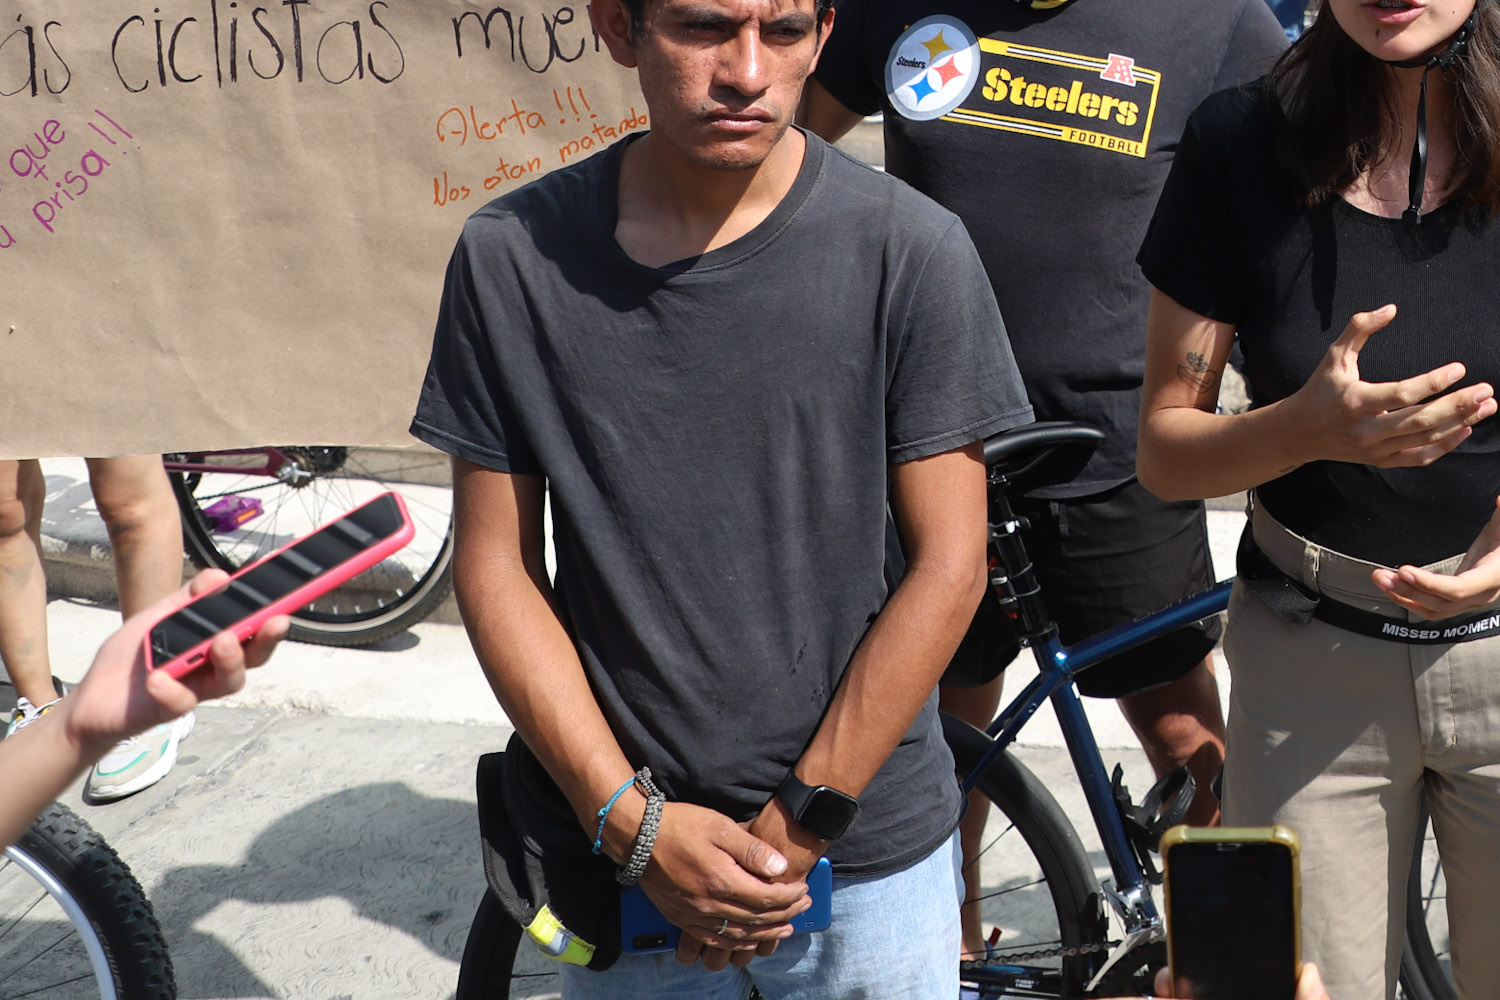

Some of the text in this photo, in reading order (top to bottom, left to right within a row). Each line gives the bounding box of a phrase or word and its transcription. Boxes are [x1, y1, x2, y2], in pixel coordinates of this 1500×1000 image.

[895, 55, 927, 70] Steelers
[980, 66, 1141, 128] Steelers
[1068, 129, 1142, 156] FOOTBALL
[433, 170, 472, 207] Nos
[1381, 622, 1441, 640] MISSED
